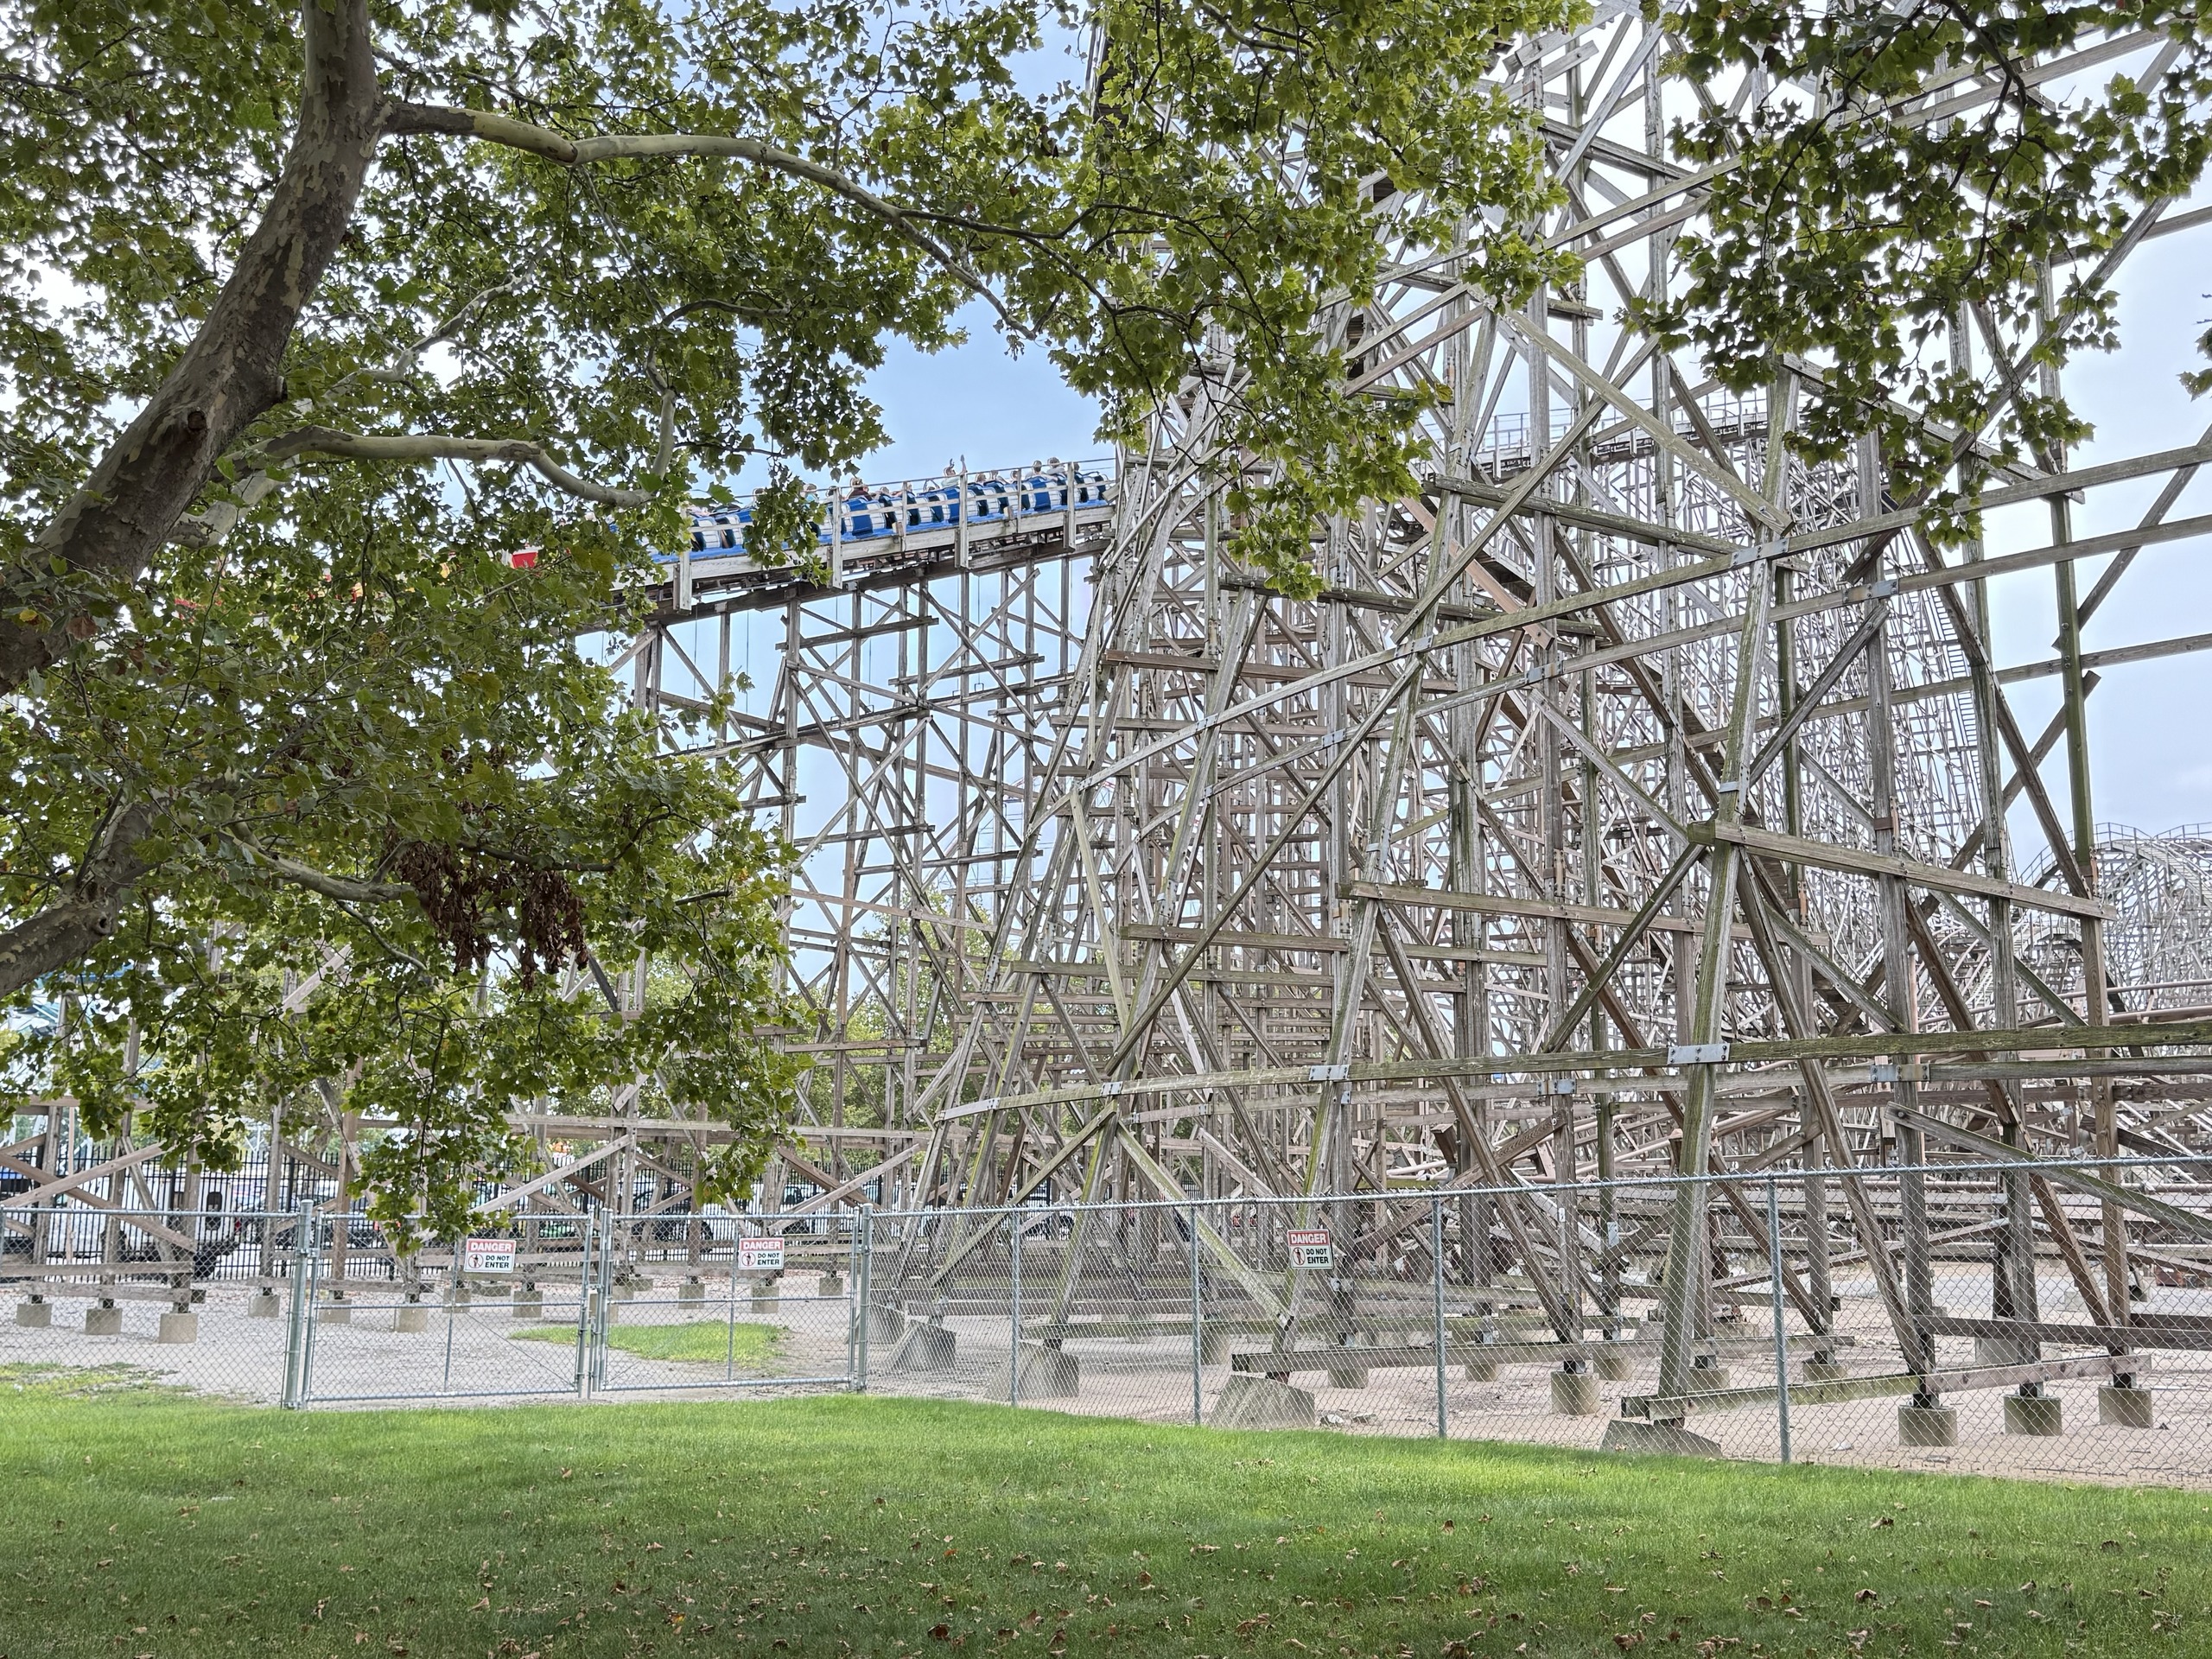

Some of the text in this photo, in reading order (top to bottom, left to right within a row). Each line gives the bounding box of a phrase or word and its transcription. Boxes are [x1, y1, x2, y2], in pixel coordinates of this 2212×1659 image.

[1290, 1233, 1326, 1244] DANGER
[471, 1242, 512, 1252] DANGER
[743, 1241, 781, 1250] DANGER
